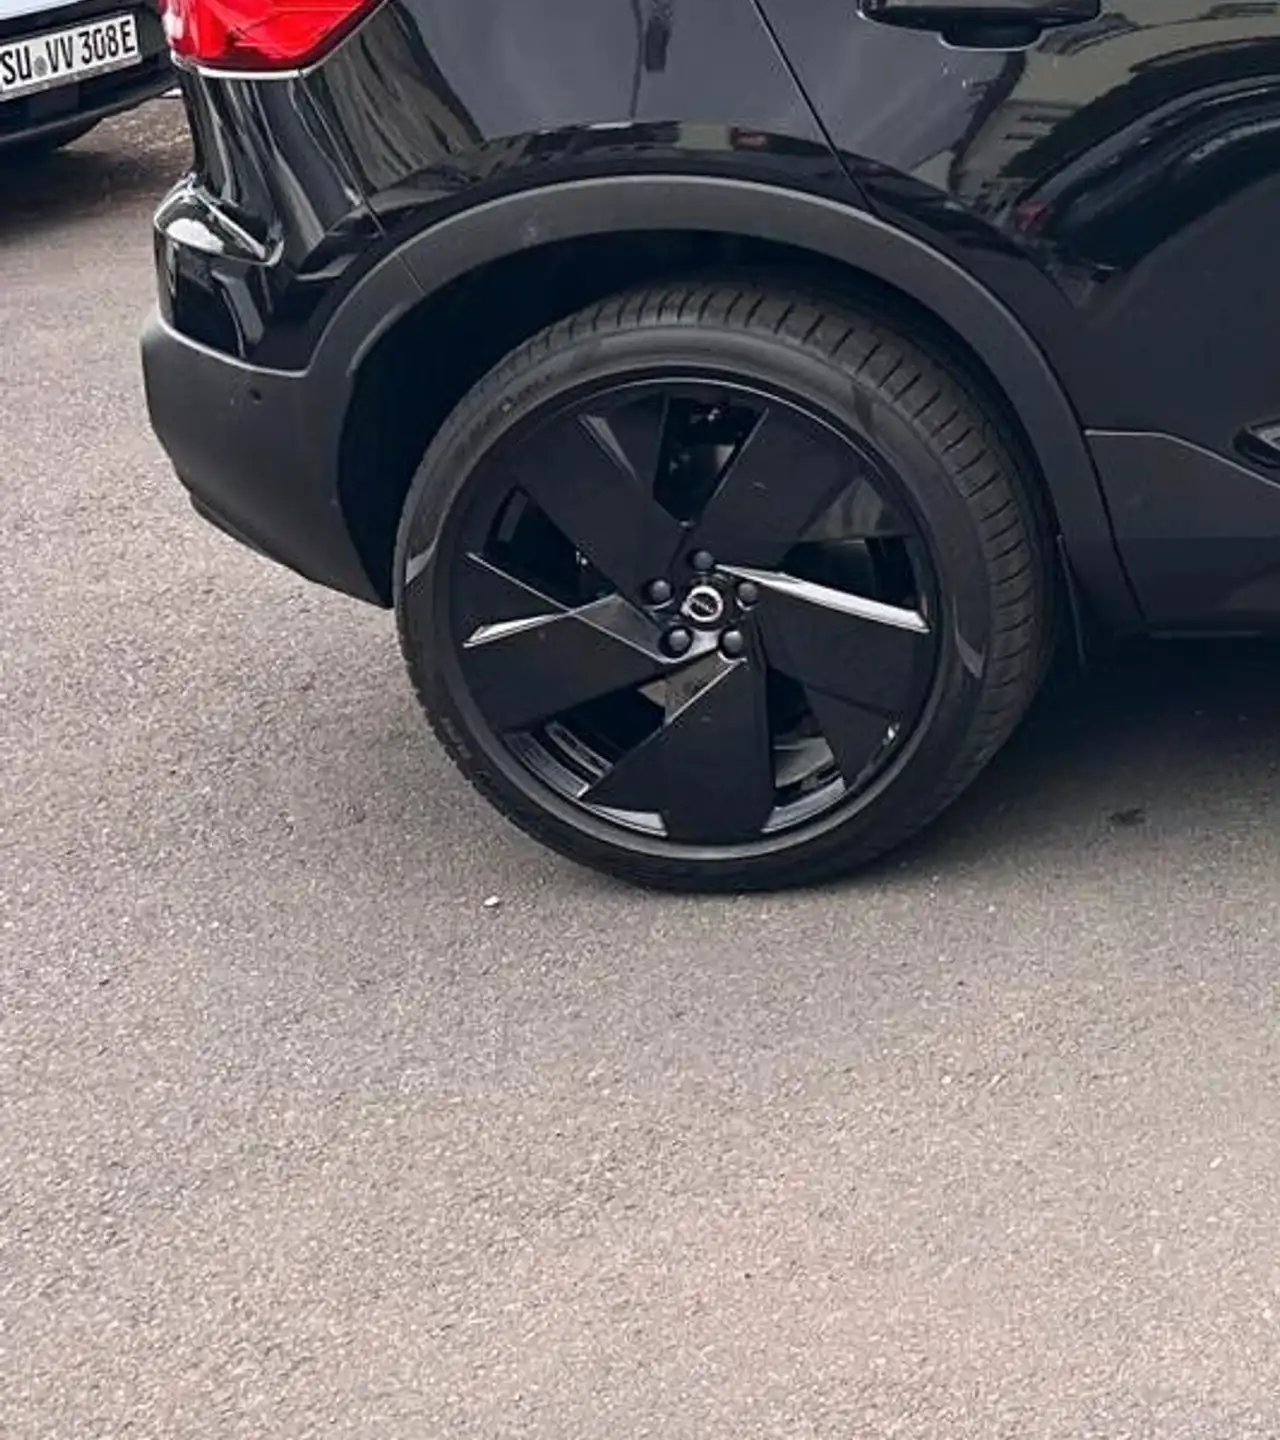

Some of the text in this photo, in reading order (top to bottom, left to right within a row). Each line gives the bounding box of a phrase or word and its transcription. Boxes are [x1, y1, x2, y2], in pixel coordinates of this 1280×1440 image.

[0, 19, 136, 86] SU VV 308E
